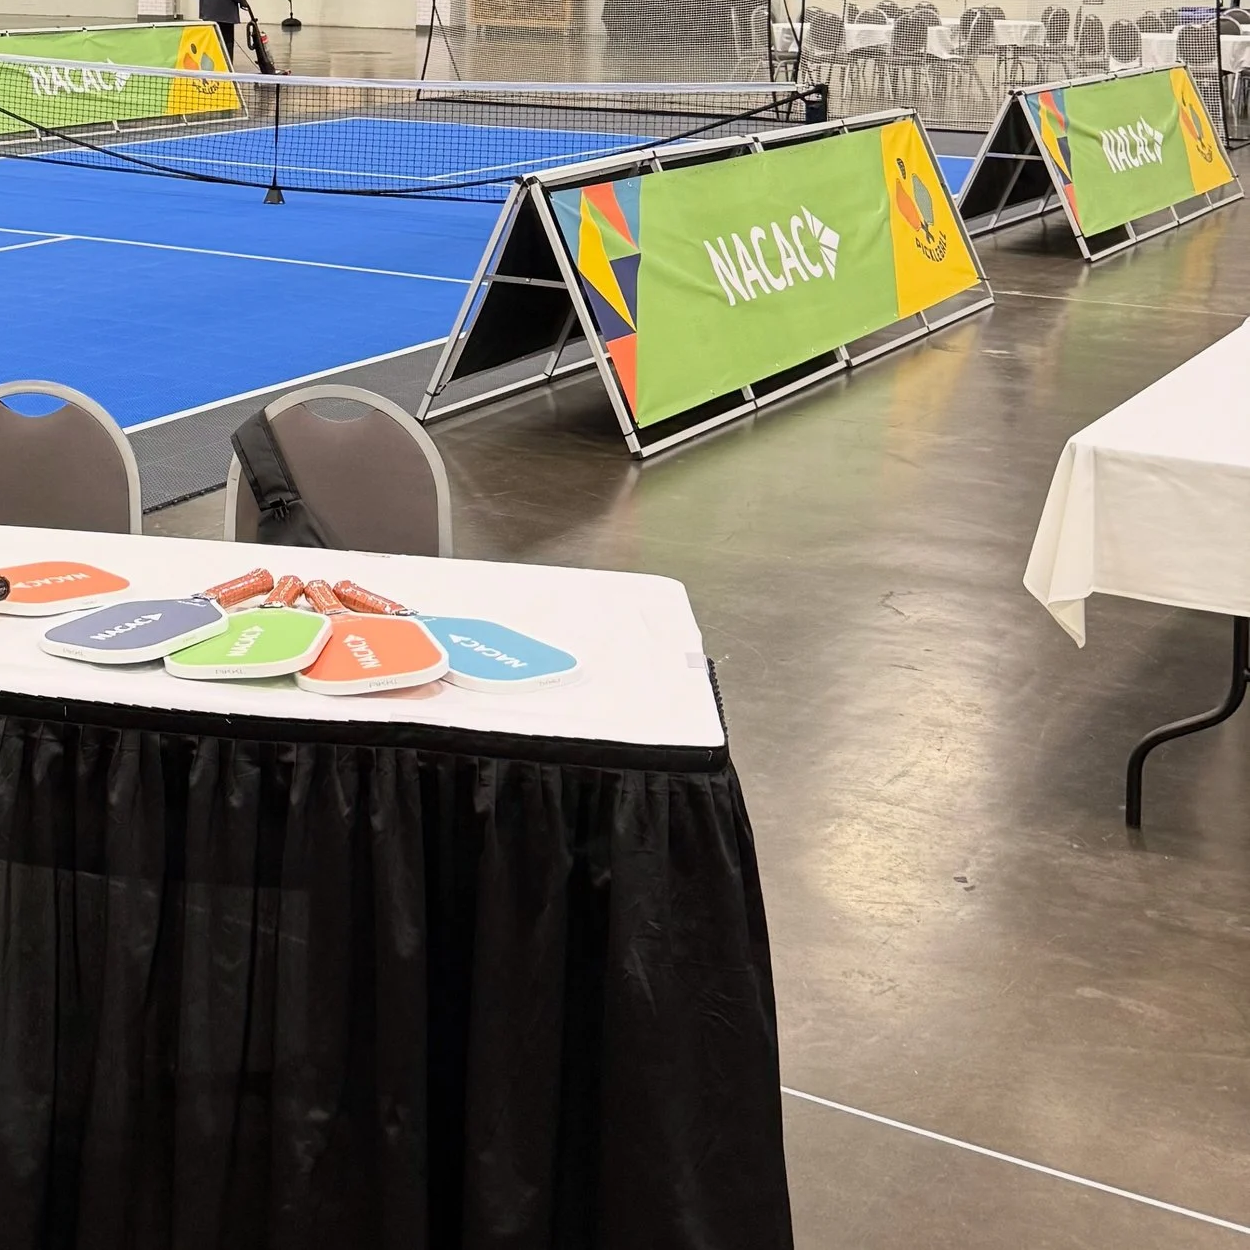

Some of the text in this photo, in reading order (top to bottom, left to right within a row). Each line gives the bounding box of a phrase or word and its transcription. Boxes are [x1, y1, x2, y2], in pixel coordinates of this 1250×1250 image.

[29, 62, 114, 96] NACAC
[1100, 121, 1158, 174] NACAC
[704, 216, 823, 306] NACAC
[30, 572, 92, 587] NACAC
[90, 615, 151, 641] NACAC
[226, 630, 262, 657] NACAC
[347, 639, 383, 669] NACAC
[459, 638, 528, 669] NACAC
